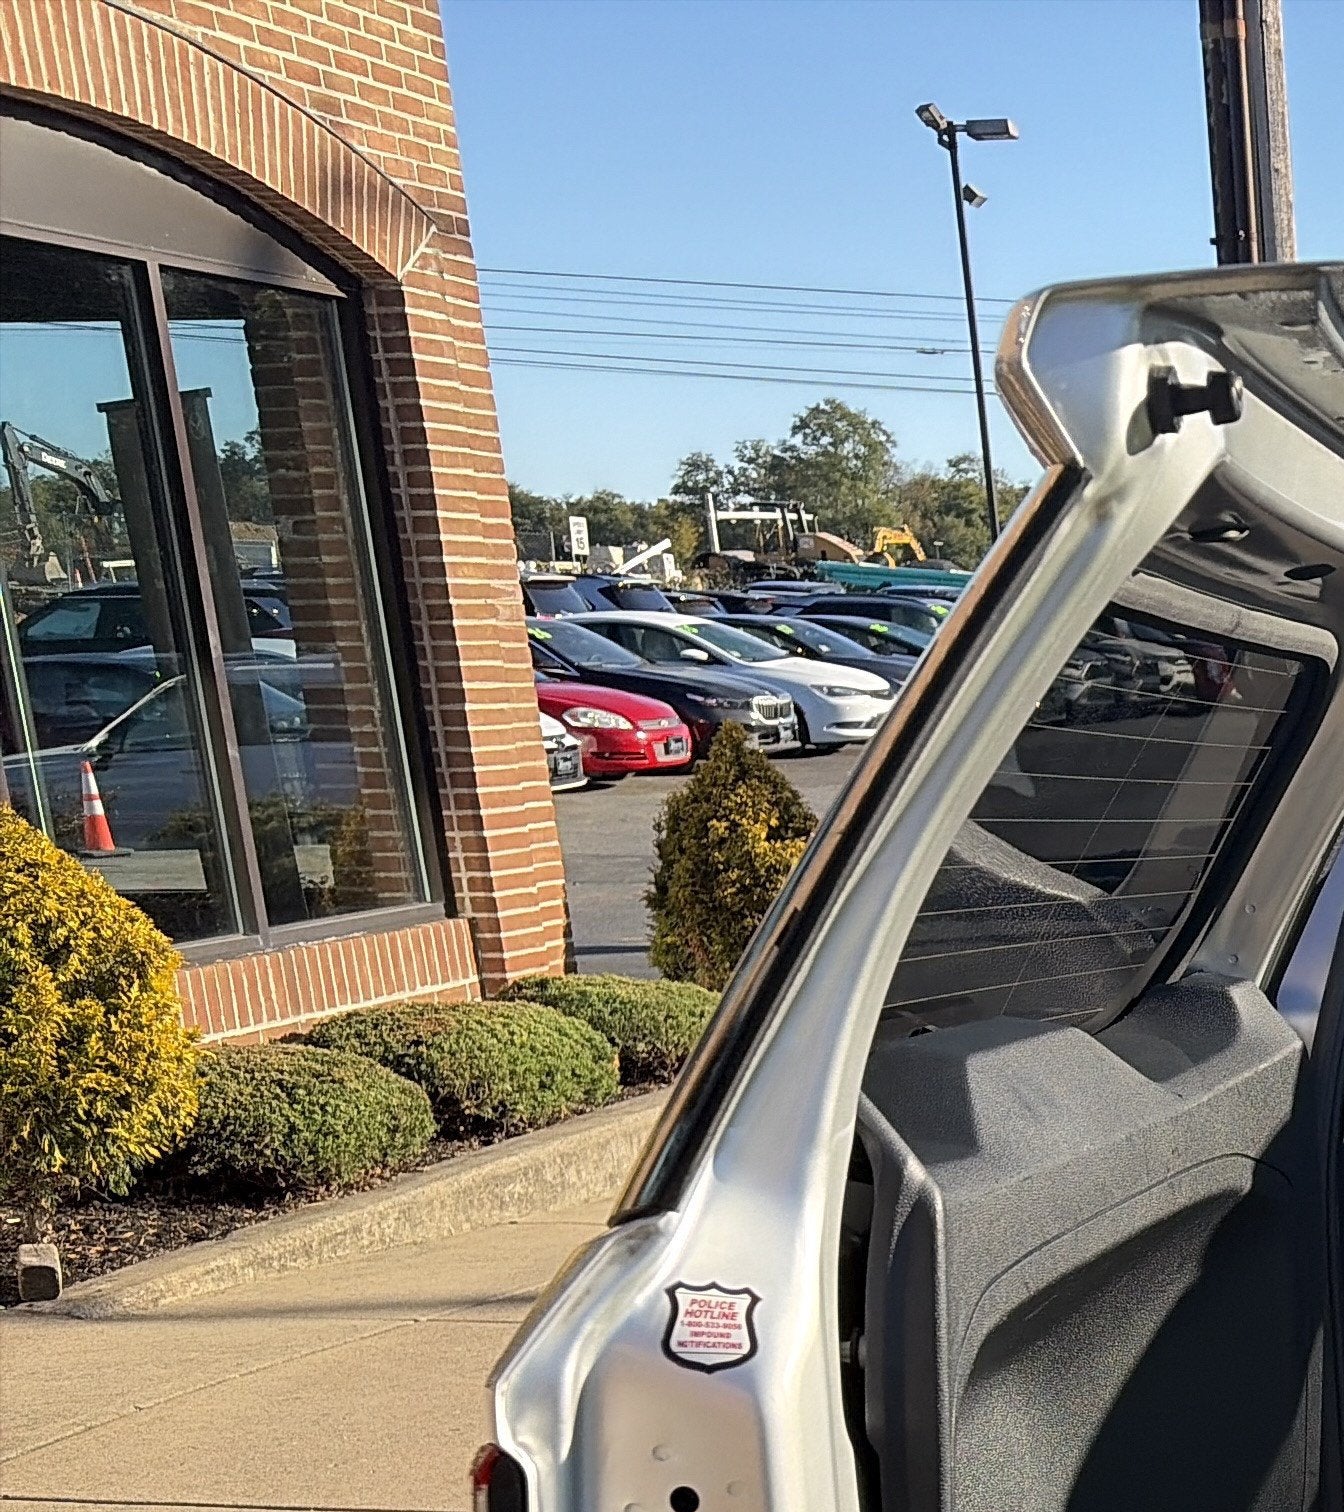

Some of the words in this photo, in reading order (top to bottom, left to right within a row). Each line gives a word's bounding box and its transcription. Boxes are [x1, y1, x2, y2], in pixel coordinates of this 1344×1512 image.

[575, 536, 585, 550] 15
[688, 1298, 737, 1311] POLICE
[684, 1308, 739, 1320] HOTLINE
[689, 1330, 732, 1339] IMPOUND
[676, 1339, 743, 1350] NOTIFICATIONS
